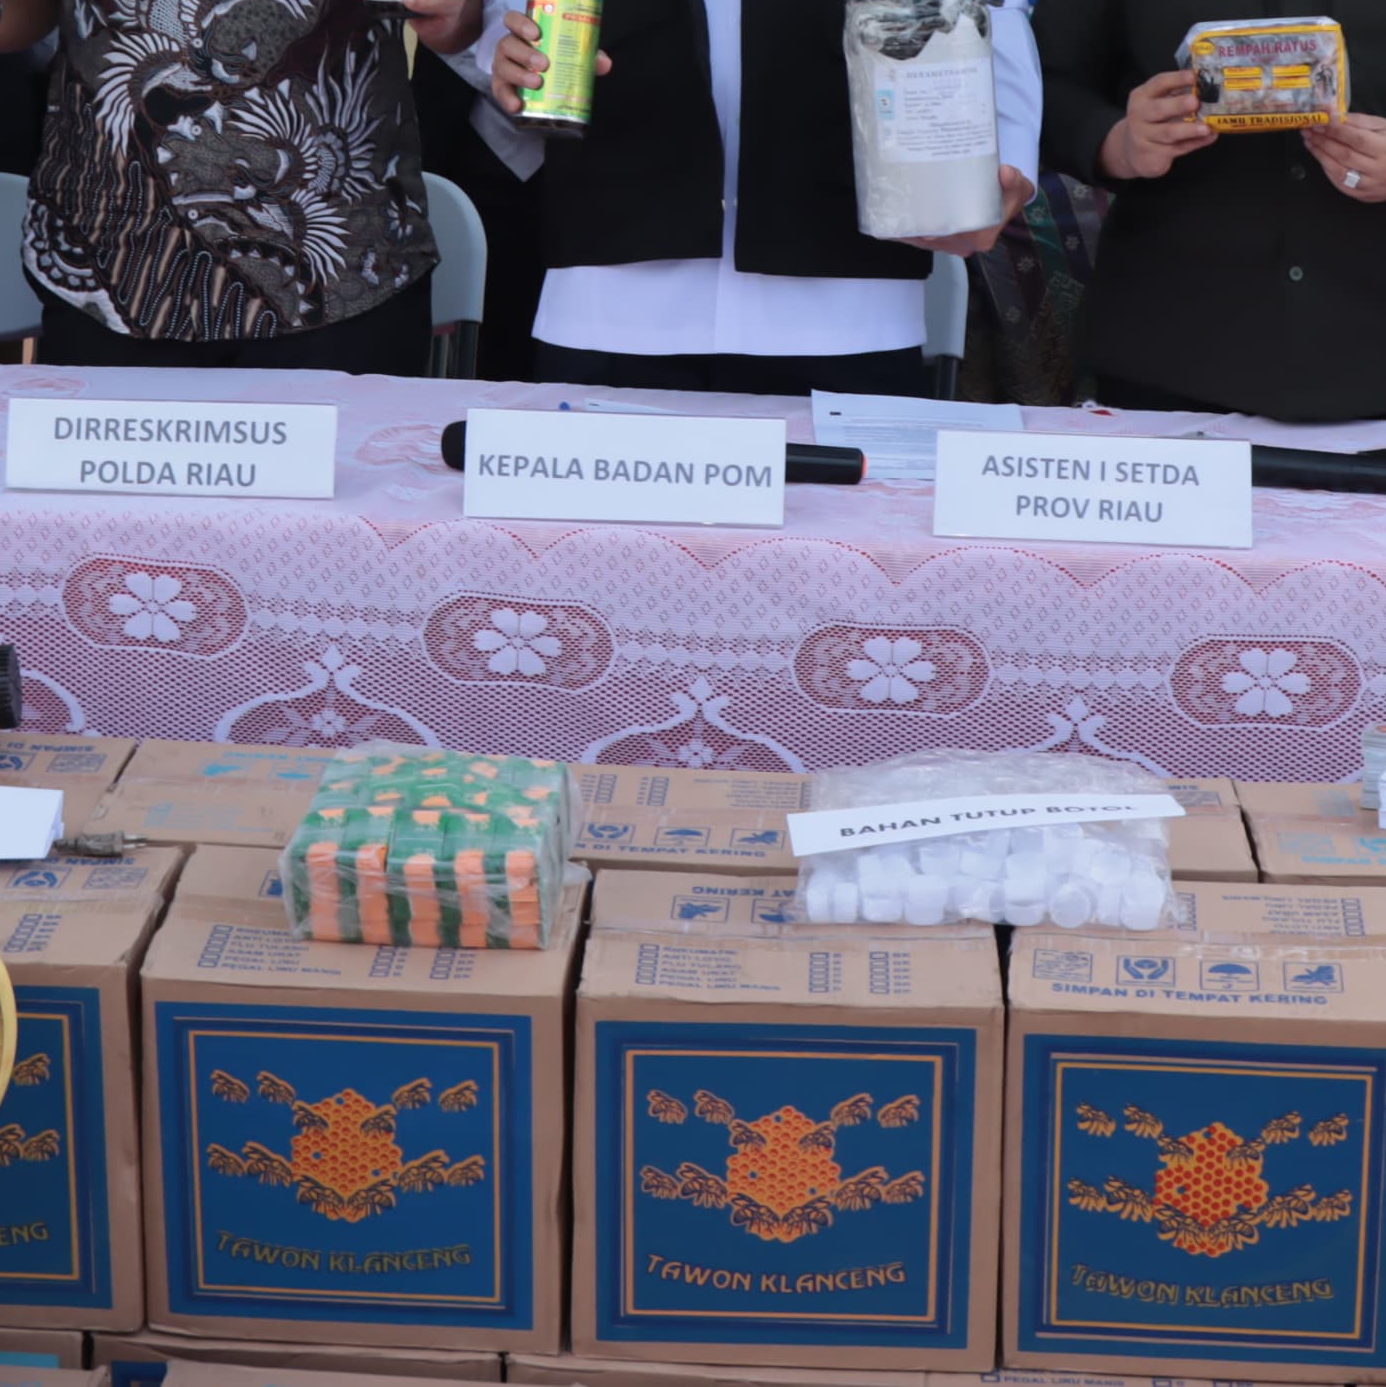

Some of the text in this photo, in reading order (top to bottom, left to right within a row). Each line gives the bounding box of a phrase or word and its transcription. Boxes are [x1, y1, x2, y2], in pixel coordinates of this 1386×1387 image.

[1218, 38, 1318, 58] REMPAH RATUS
[1250, 114, 1322, 126] TRADISIONAL
[53, 416, 288, 445] DIRRESKRIMSUS
[79, 459, 257, 487] POLDA RIAU
[478, 454, 773, 488] KEPALA BADAN POM
[981, 455, 1201, 487] ASISTEN I SETDA
[1015, 495, 1165, 524] PROV RIAU
[840, 817, 941, 837] BAHAN
[950, 808, 1036, 822] TUTUP
[619, 845, 689, 855] TEMPAT
[695, 849, 766, 858] KERING
[1052, 982, 1328, 1005] SIMPAN DI TEMPAT KERING
[216, 1229, 472, 1274] TAWON KLANCENG
[646, 1253, 907, 1295] TAWON KLANCENG
[1070, 1261, 1335, 1308] TAWON KLANCENG
